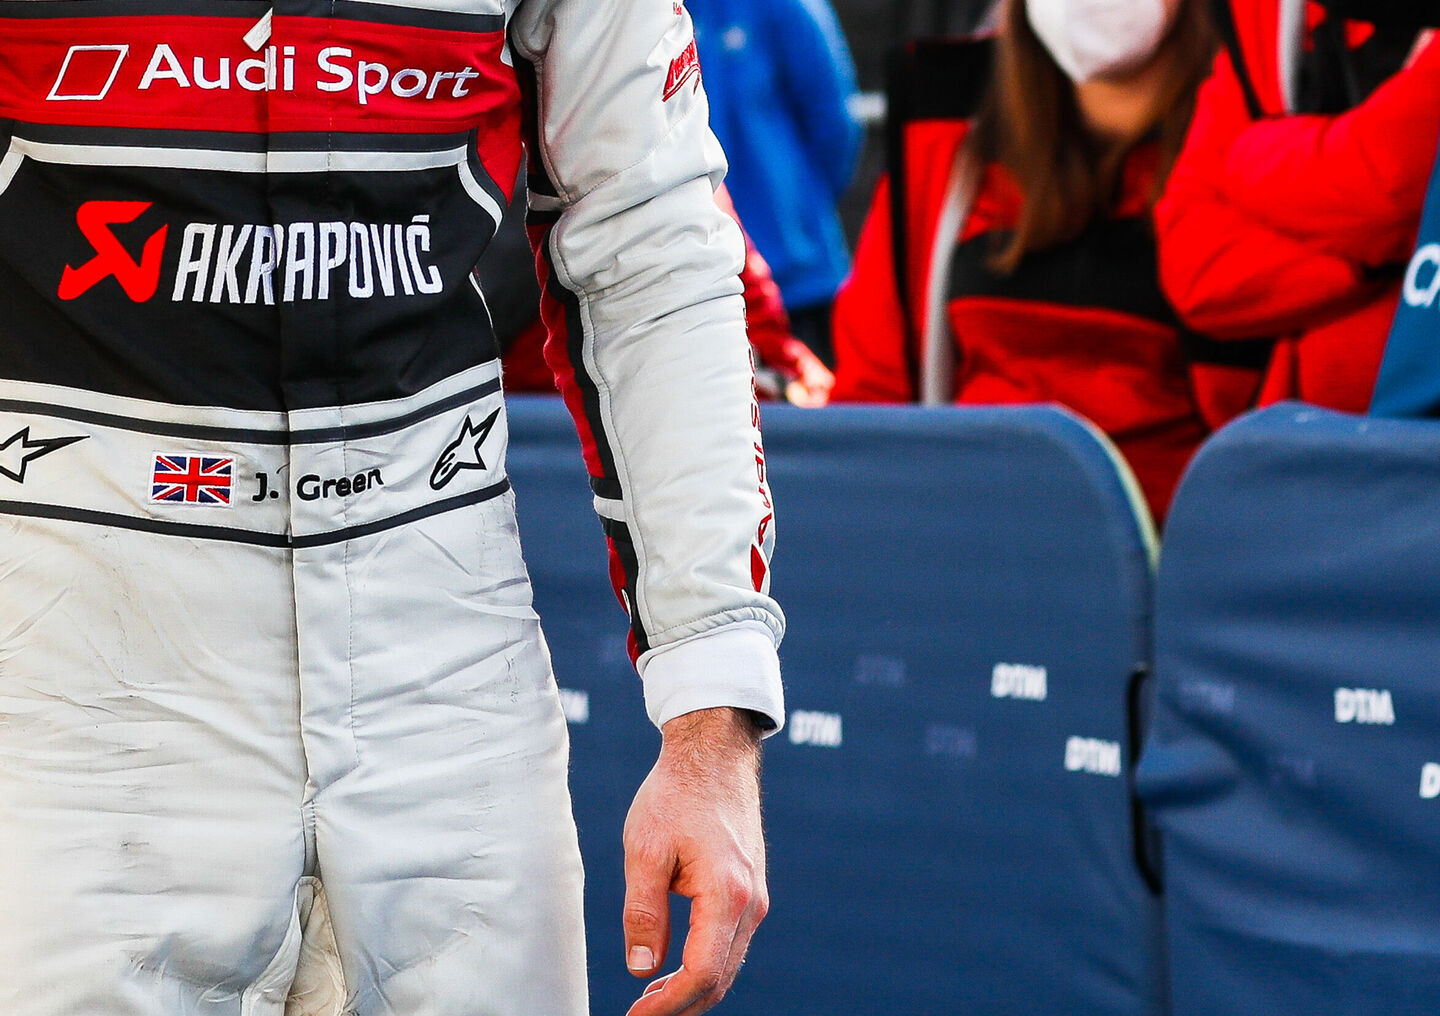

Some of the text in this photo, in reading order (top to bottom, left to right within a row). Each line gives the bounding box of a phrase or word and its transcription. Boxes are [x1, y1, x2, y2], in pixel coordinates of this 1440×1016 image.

[138, 40, 480, 104] Audi Sport
[252, 466, 385, 502] J. Green
[1332, 686, 1395, 725] DTM
